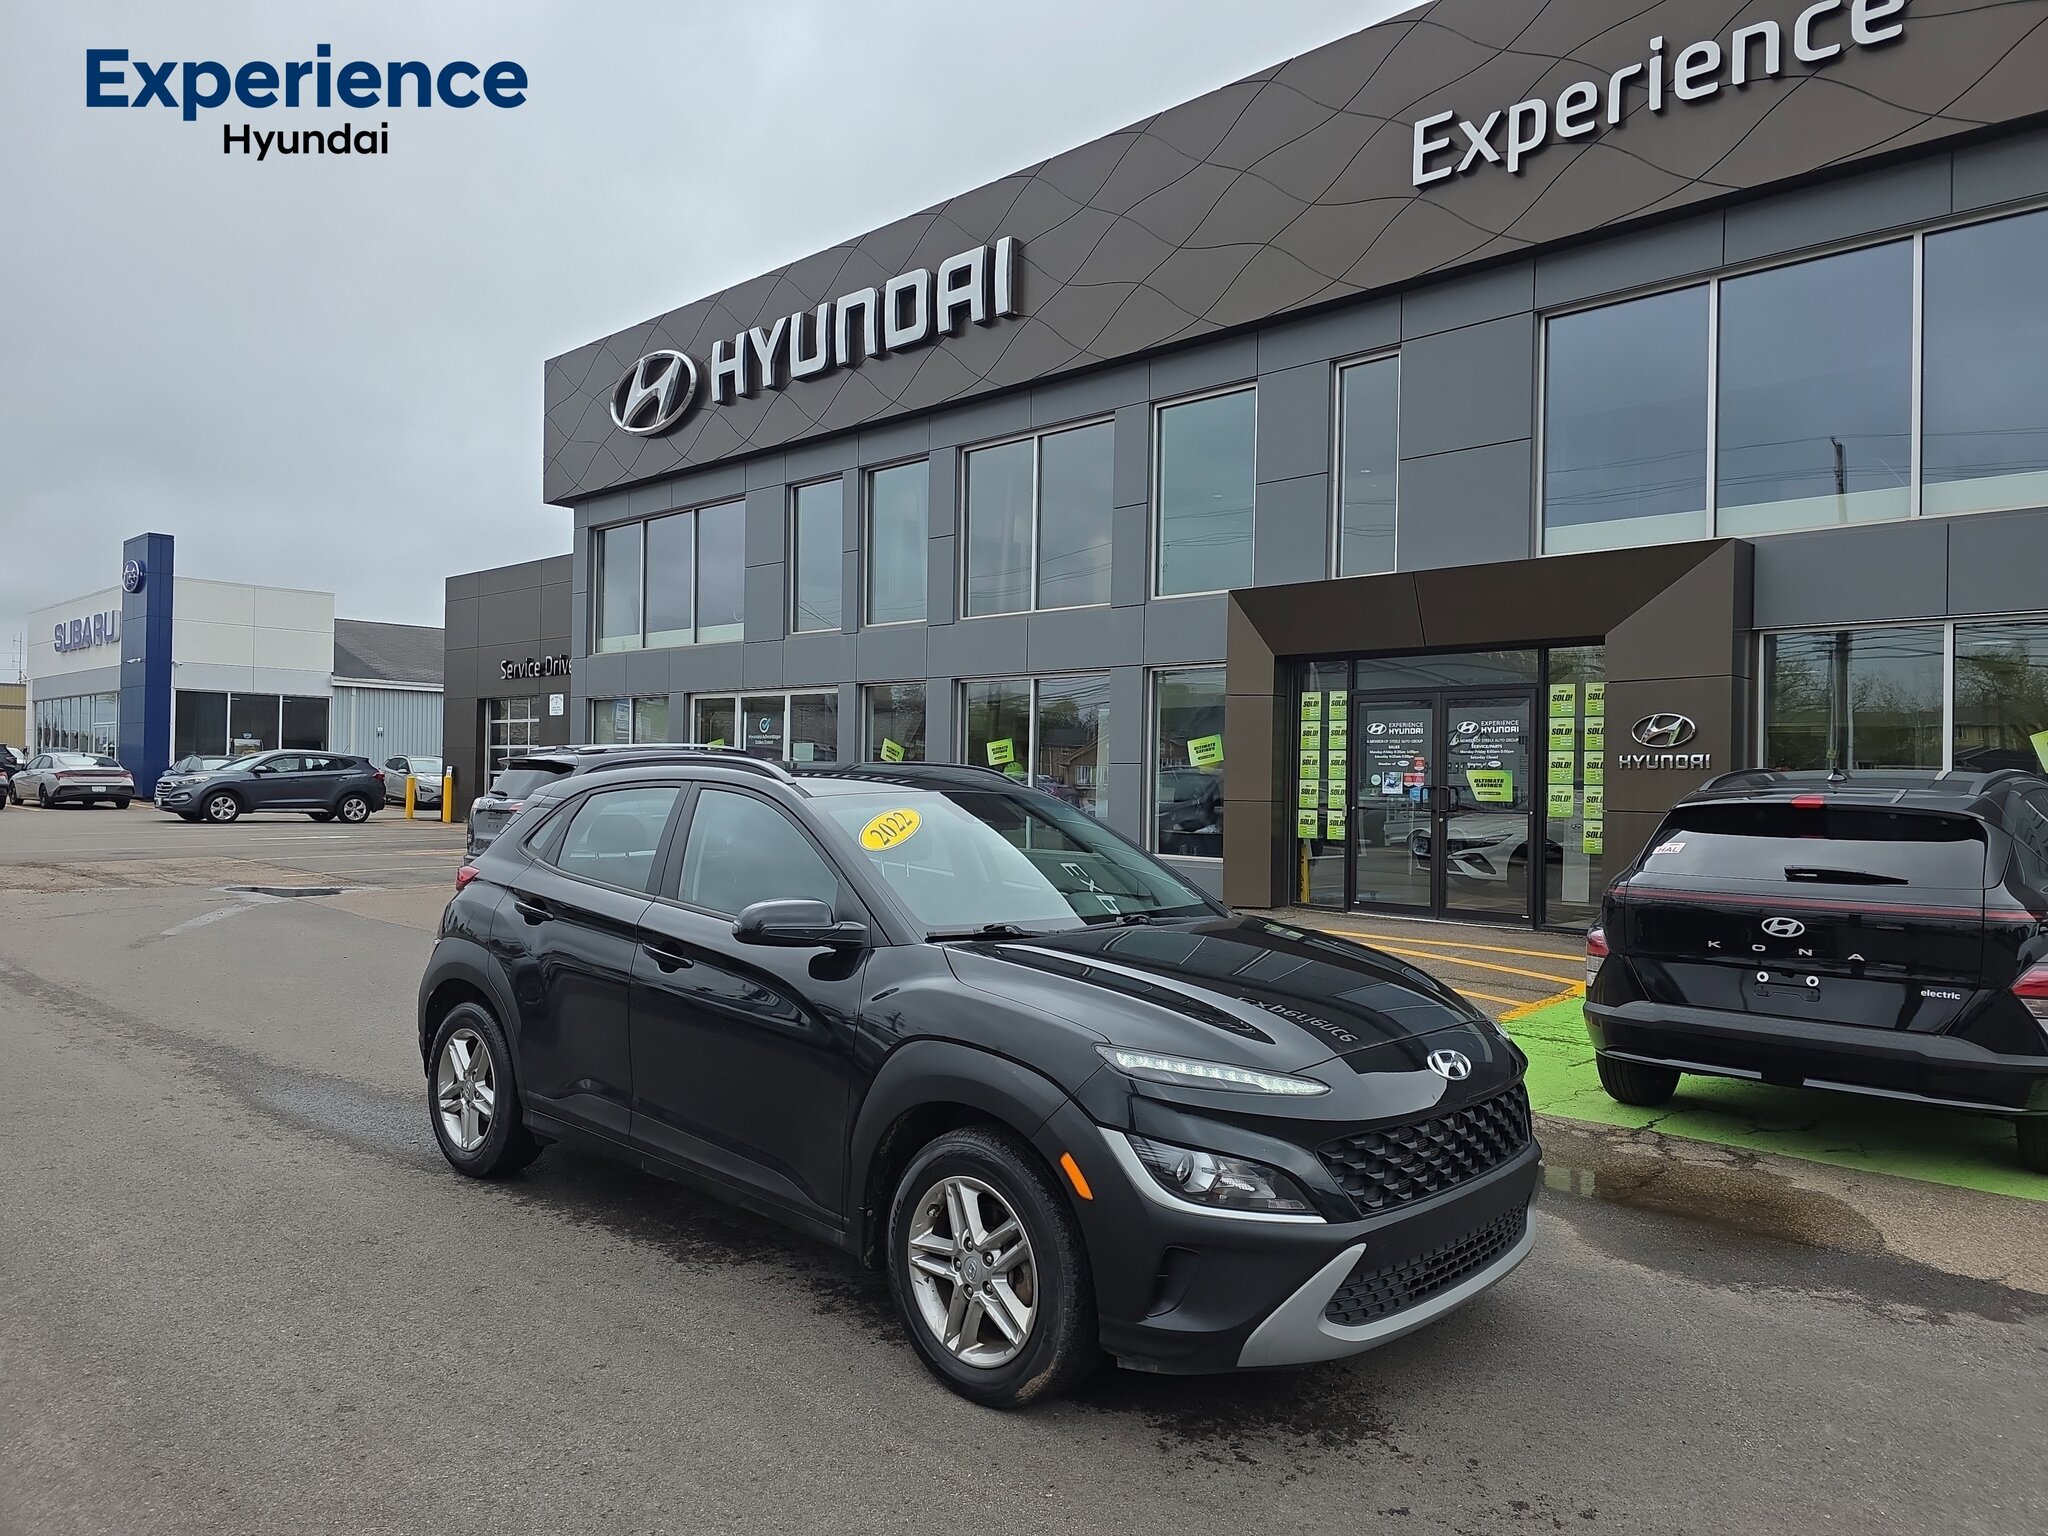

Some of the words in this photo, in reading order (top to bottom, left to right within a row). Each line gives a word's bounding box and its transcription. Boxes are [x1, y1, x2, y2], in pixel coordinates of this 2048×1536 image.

[1413, 0, 1903, 186] Experience
[711, 235, 1017, 403] HYUNDAI
[54, 610, 121, 653] SUBARU
[500, 657, 540, 679] Service
[545, 654, 572, 676] Drive
[1552, 694, 1573, 702] SOLD!
[1619, 754, 1711, 769] HYUNDAI
[870, 812, 913, 845] 2022
[1708, 940, 1865, 961] KONA
[1920, 989, 1961, 1000] electric
